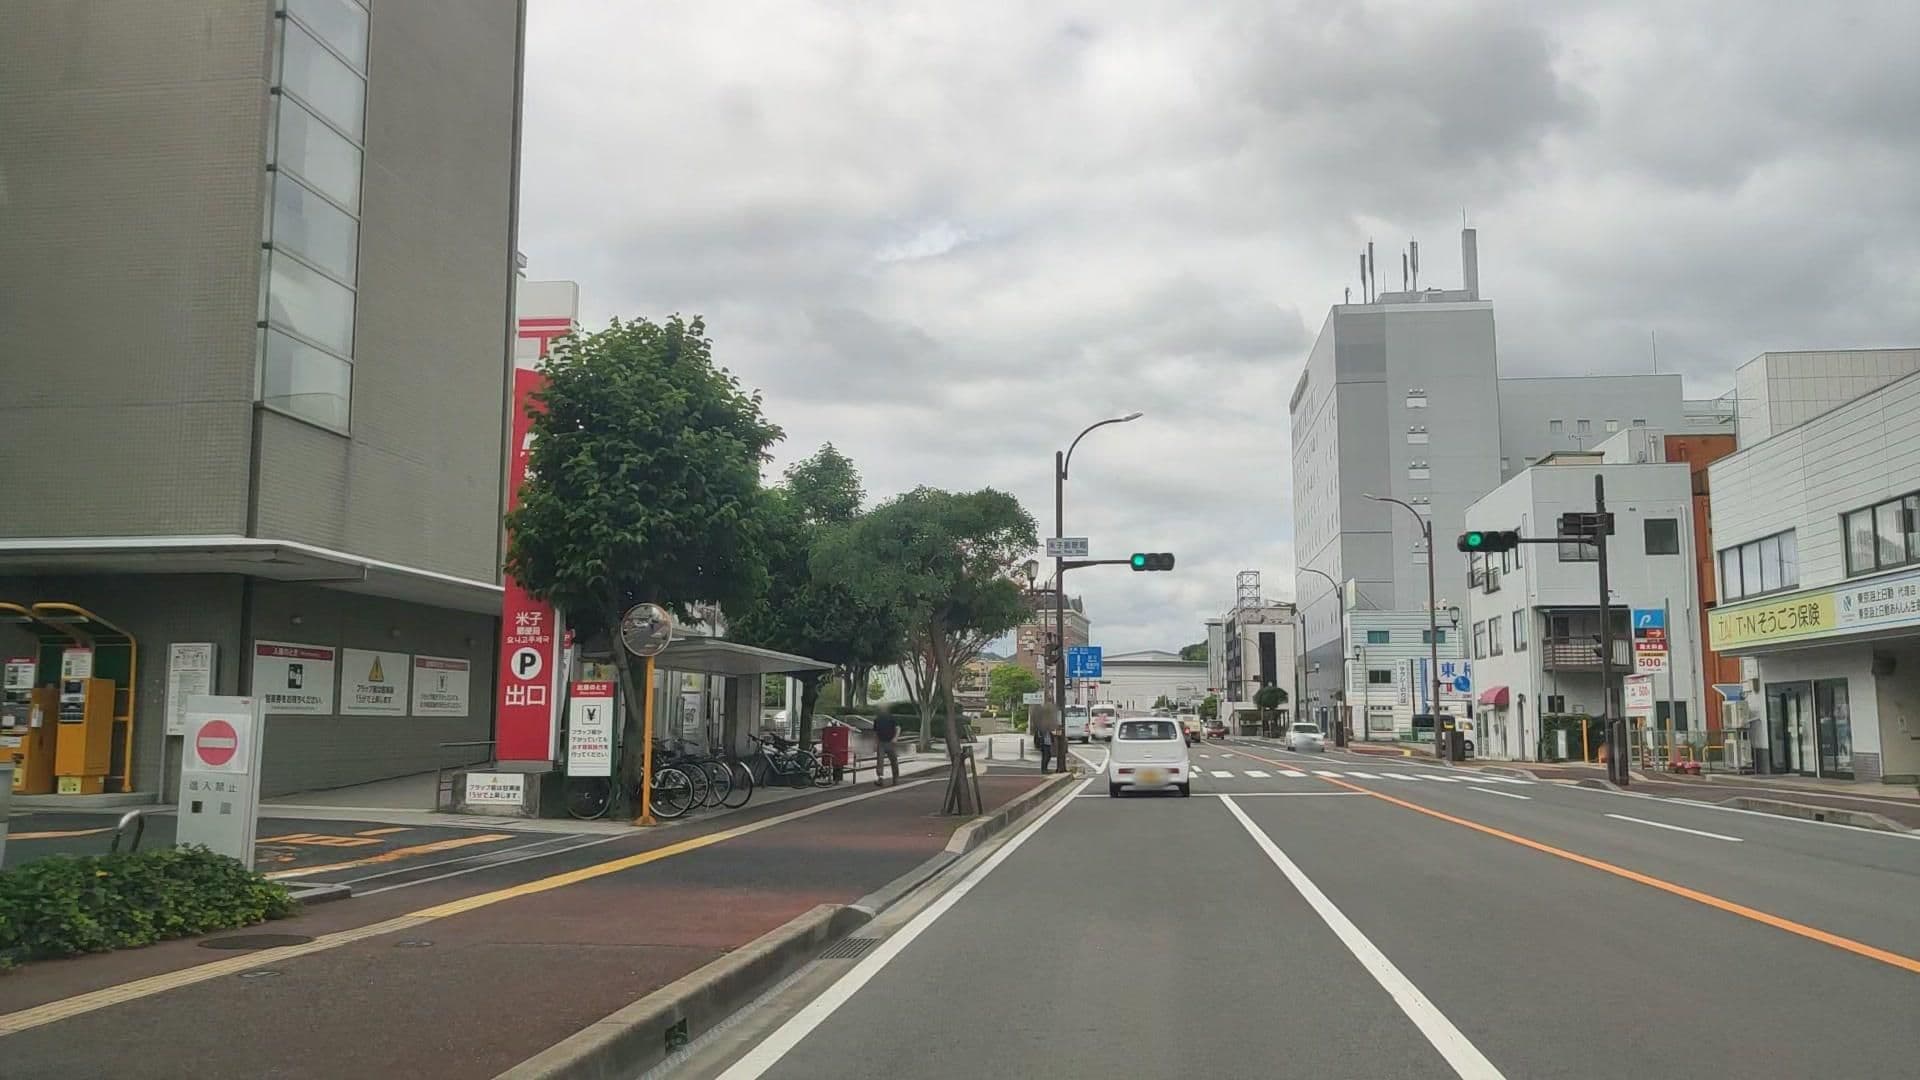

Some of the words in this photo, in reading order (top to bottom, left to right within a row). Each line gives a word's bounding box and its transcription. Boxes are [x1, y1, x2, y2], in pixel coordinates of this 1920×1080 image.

[515, 611, 543, 626] 米子
[520, 653, 536, 675] P
[505, 684, 546, 706] 出口
[189, 780, 237, 793] 進入禁止
